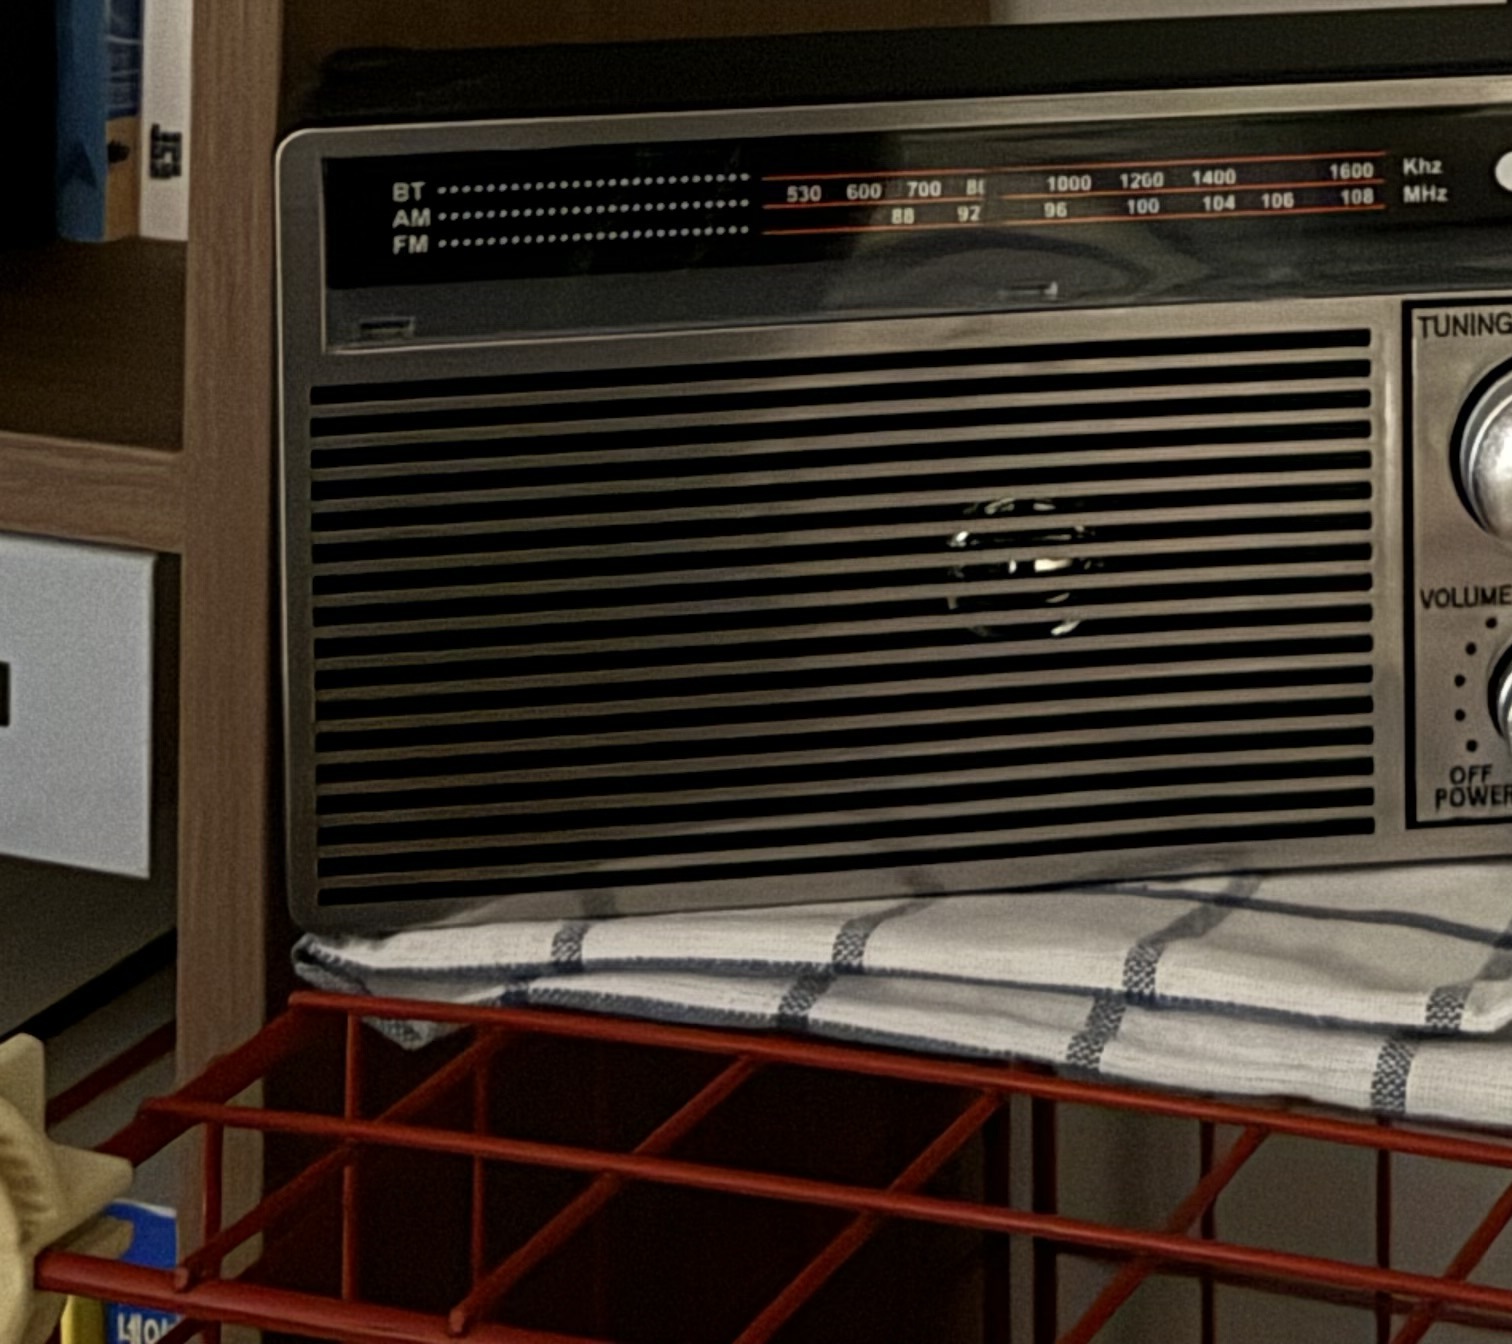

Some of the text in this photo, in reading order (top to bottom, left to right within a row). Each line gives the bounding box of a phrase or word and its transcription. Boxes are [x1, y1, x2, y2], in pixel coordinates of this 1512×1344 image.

[788, 185, 822, 203] 530
[847, 183, 882, 200] 600
[907, 180, 942, 198] 700
[1047, 175, 1092, 193] 1000
[1120, 172, 1165, 190] 1200
[1192, 169, 1236, 185] 1400
[1330, 163, 1374, 179] 1600
[1403, 158, 1442, 175] Khz
[392, 182, 425, 202] BT
[892, 186, 1448, 225] 88 92 96 100 104 106 108 MHz
[392, 208, 431, 228] AM
[393, 234, 428, 254] FM
[1420, 585, 1512, 609] VOLUME
[1450, 765, 1492, 786] OFF
